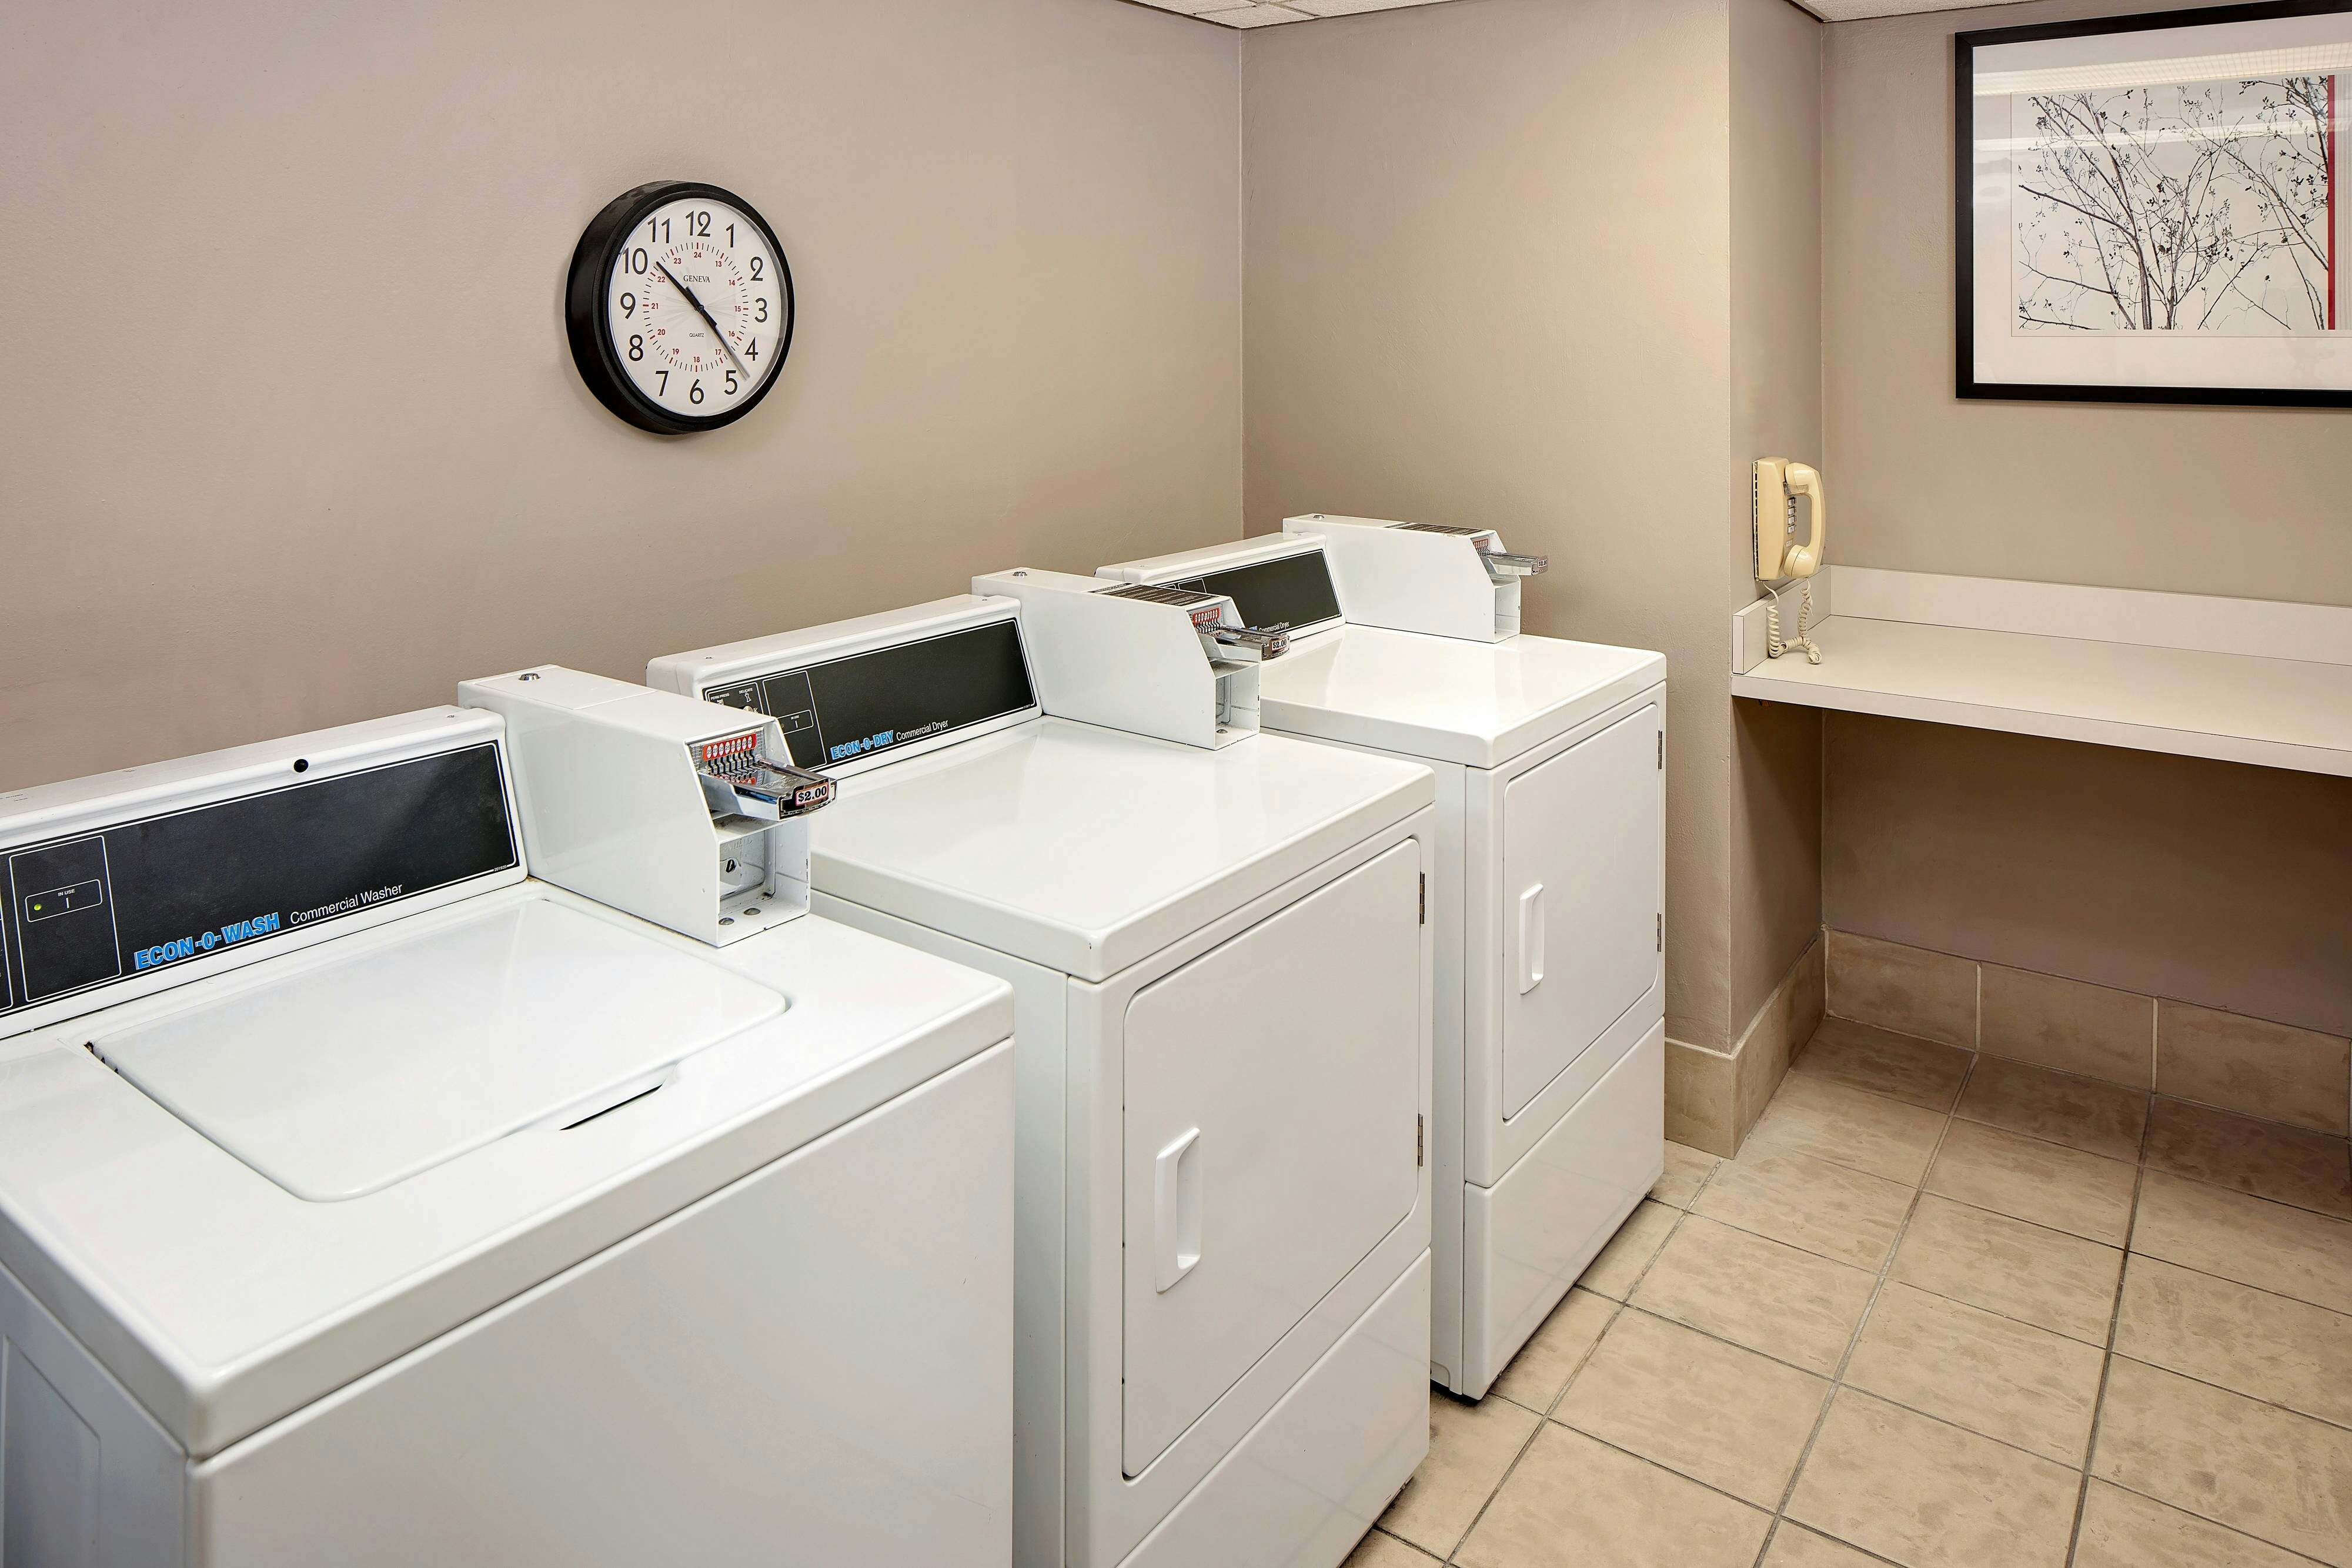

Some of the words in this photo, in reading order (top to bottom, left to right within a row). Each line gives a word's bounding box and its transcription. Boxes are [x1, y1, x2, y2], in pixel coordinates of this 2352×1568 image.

[648, 216, 670, 243] 11
[686, 210, 711, 237] 12
[726, 223, 734, 248] 1
[622, 248, 648, 275] 10
[750, 256, 763, 281] 2
[683, 275, 710, 283] GENEVA
[620, 292, 636, 319] 9
[754, 297, 768, 323] 3
[629, 335, 644, 362] 8
[744, 337, 759, 361] 4
[655, 370, 669, 397] 7
[690, 379, 704, 404] 6
[724, 370, 738, 395] 5
[1272, 639, 1287, 649] $2.00
[896, 724, 931, 741] Commercial
[932, 720, 948, 731] Dryer
[798, 785, 827, 802] $2.00
[290, 894, 359, 924] Commercial
[360, 884, 403, 904] Washer
